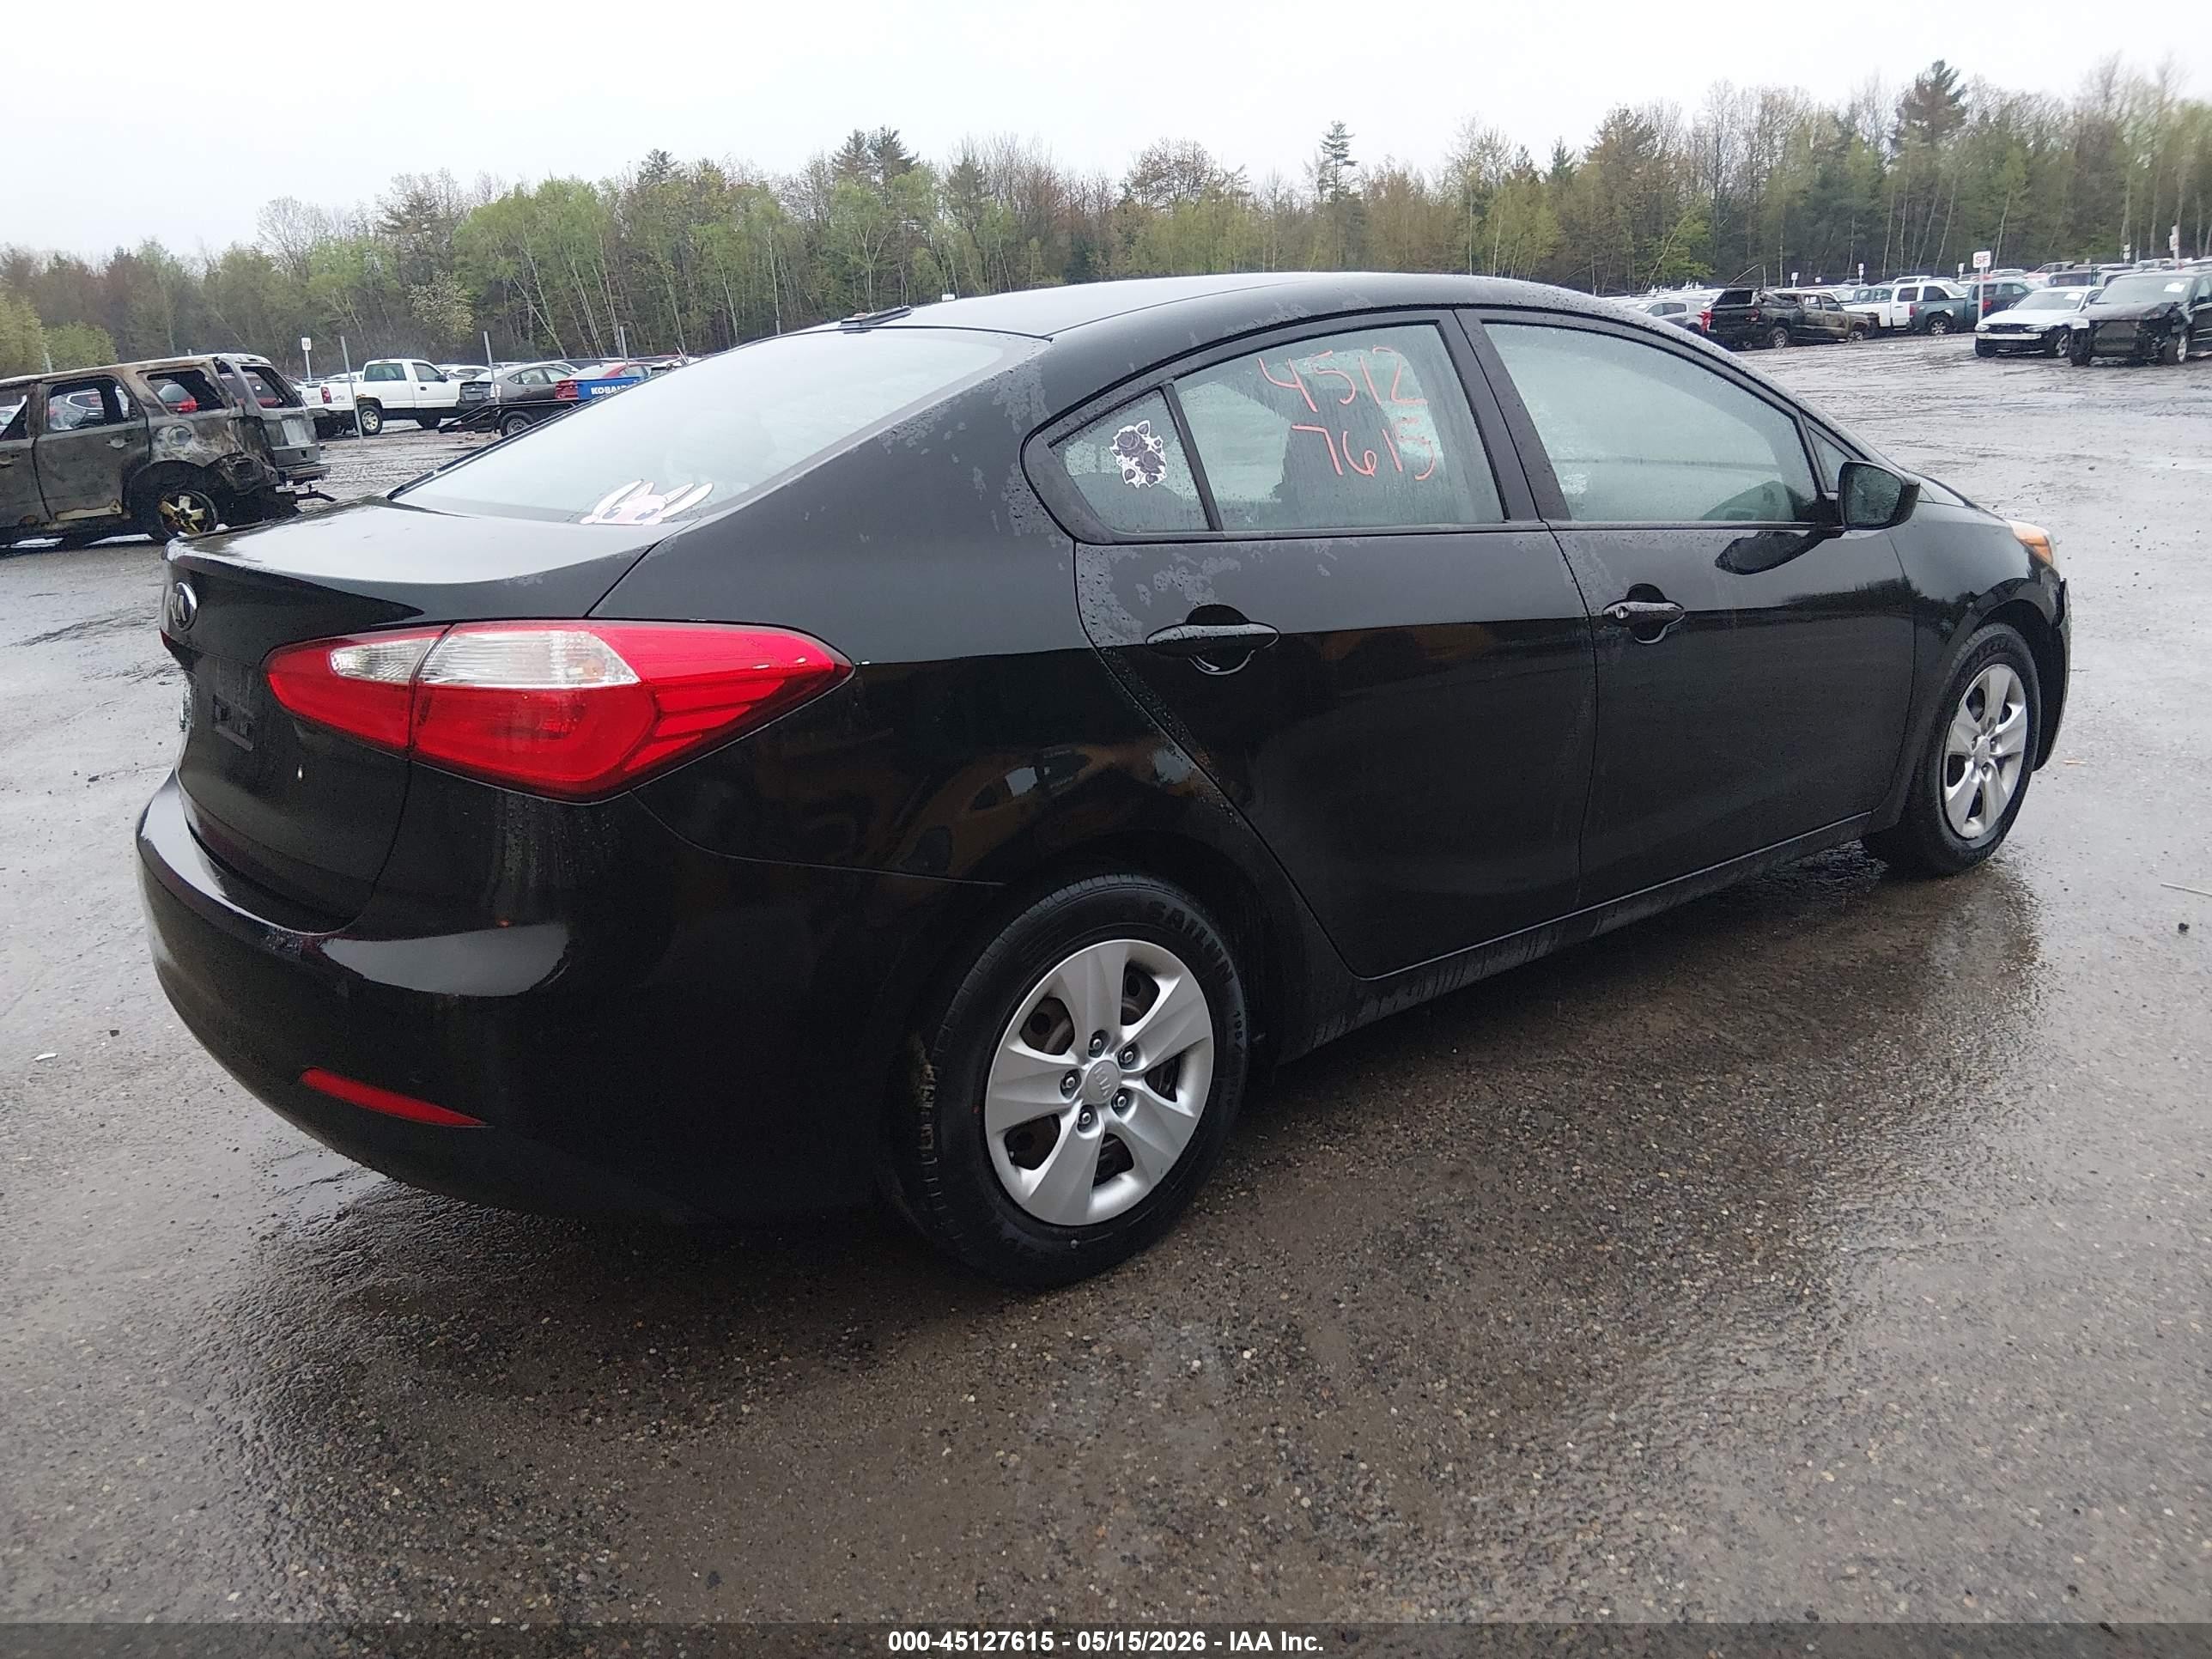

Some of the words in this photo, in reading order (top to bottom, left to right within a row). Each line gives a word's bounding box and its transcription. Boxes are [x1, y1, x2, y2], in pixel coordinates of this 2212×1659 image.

[1975, 254, 1990, 264] SF
[1258, 344, 1429, 413] 4512
[1291, 416, 1437, 481] 7615
